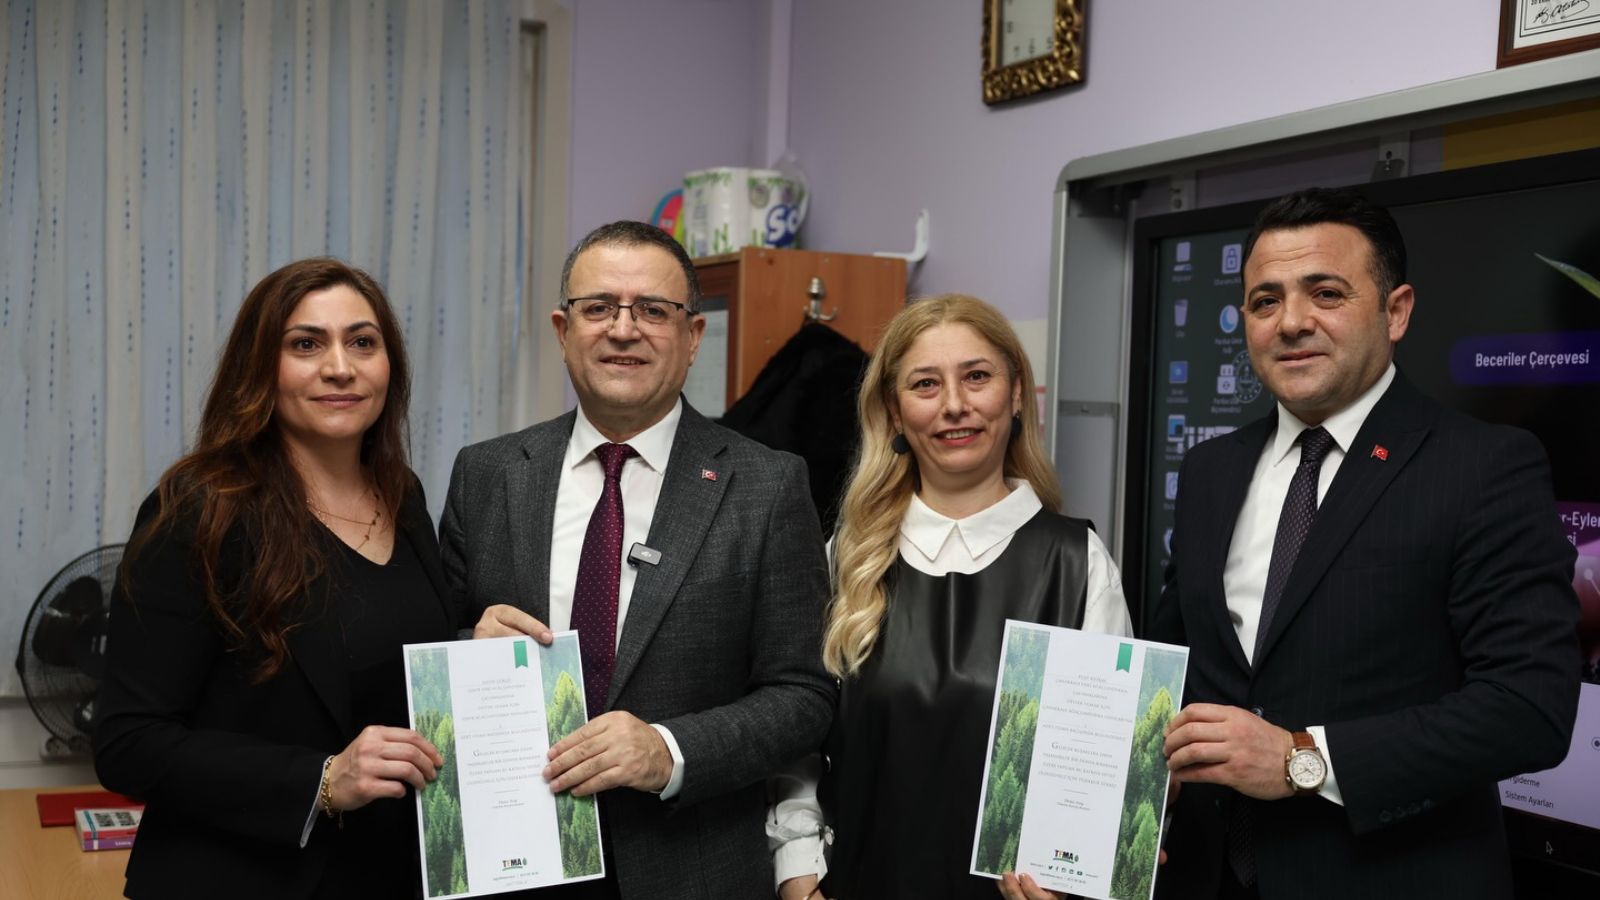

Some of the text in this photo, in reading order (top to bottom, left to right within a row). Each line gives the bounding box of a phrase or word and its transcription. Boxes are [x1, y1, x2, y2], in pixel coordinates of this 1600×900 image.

[1476, 350, 1590, 368] Beceriler Çerçevesi
[1505, 790, 1527, 802] Sistem
[502, 857, 522, 867] TEMA
